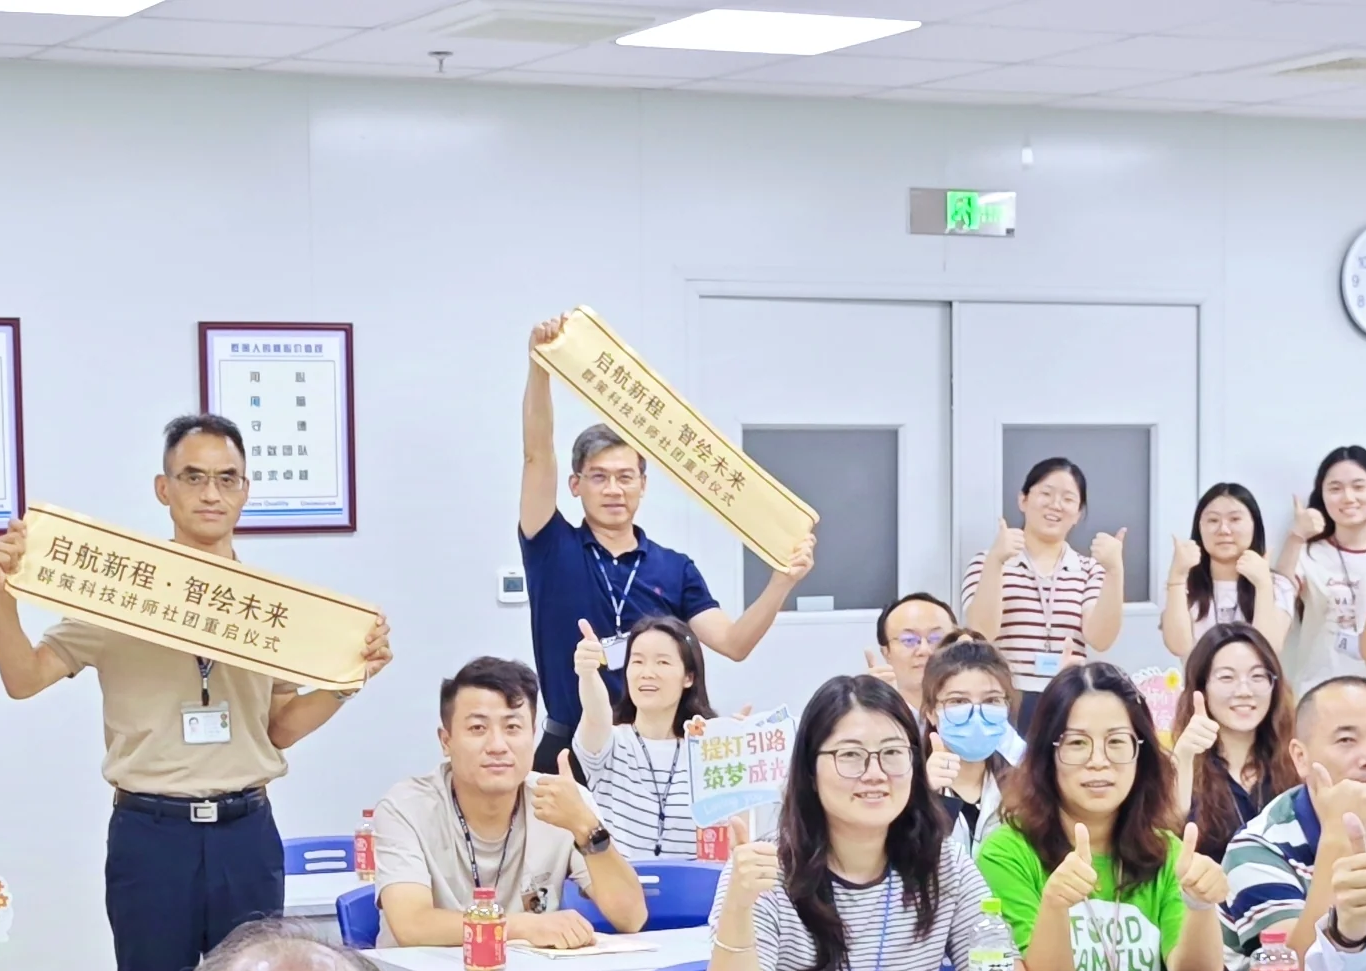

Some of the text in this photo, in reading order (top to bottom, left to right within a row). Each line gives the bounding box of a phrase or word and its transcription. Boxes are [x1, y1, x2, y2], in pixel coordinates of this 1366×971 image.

[581, 368, 736, 507] 群策科技讲师社团重启仪式
[37, 565, 281, 653] 群策科技讲师社团重启仪式
